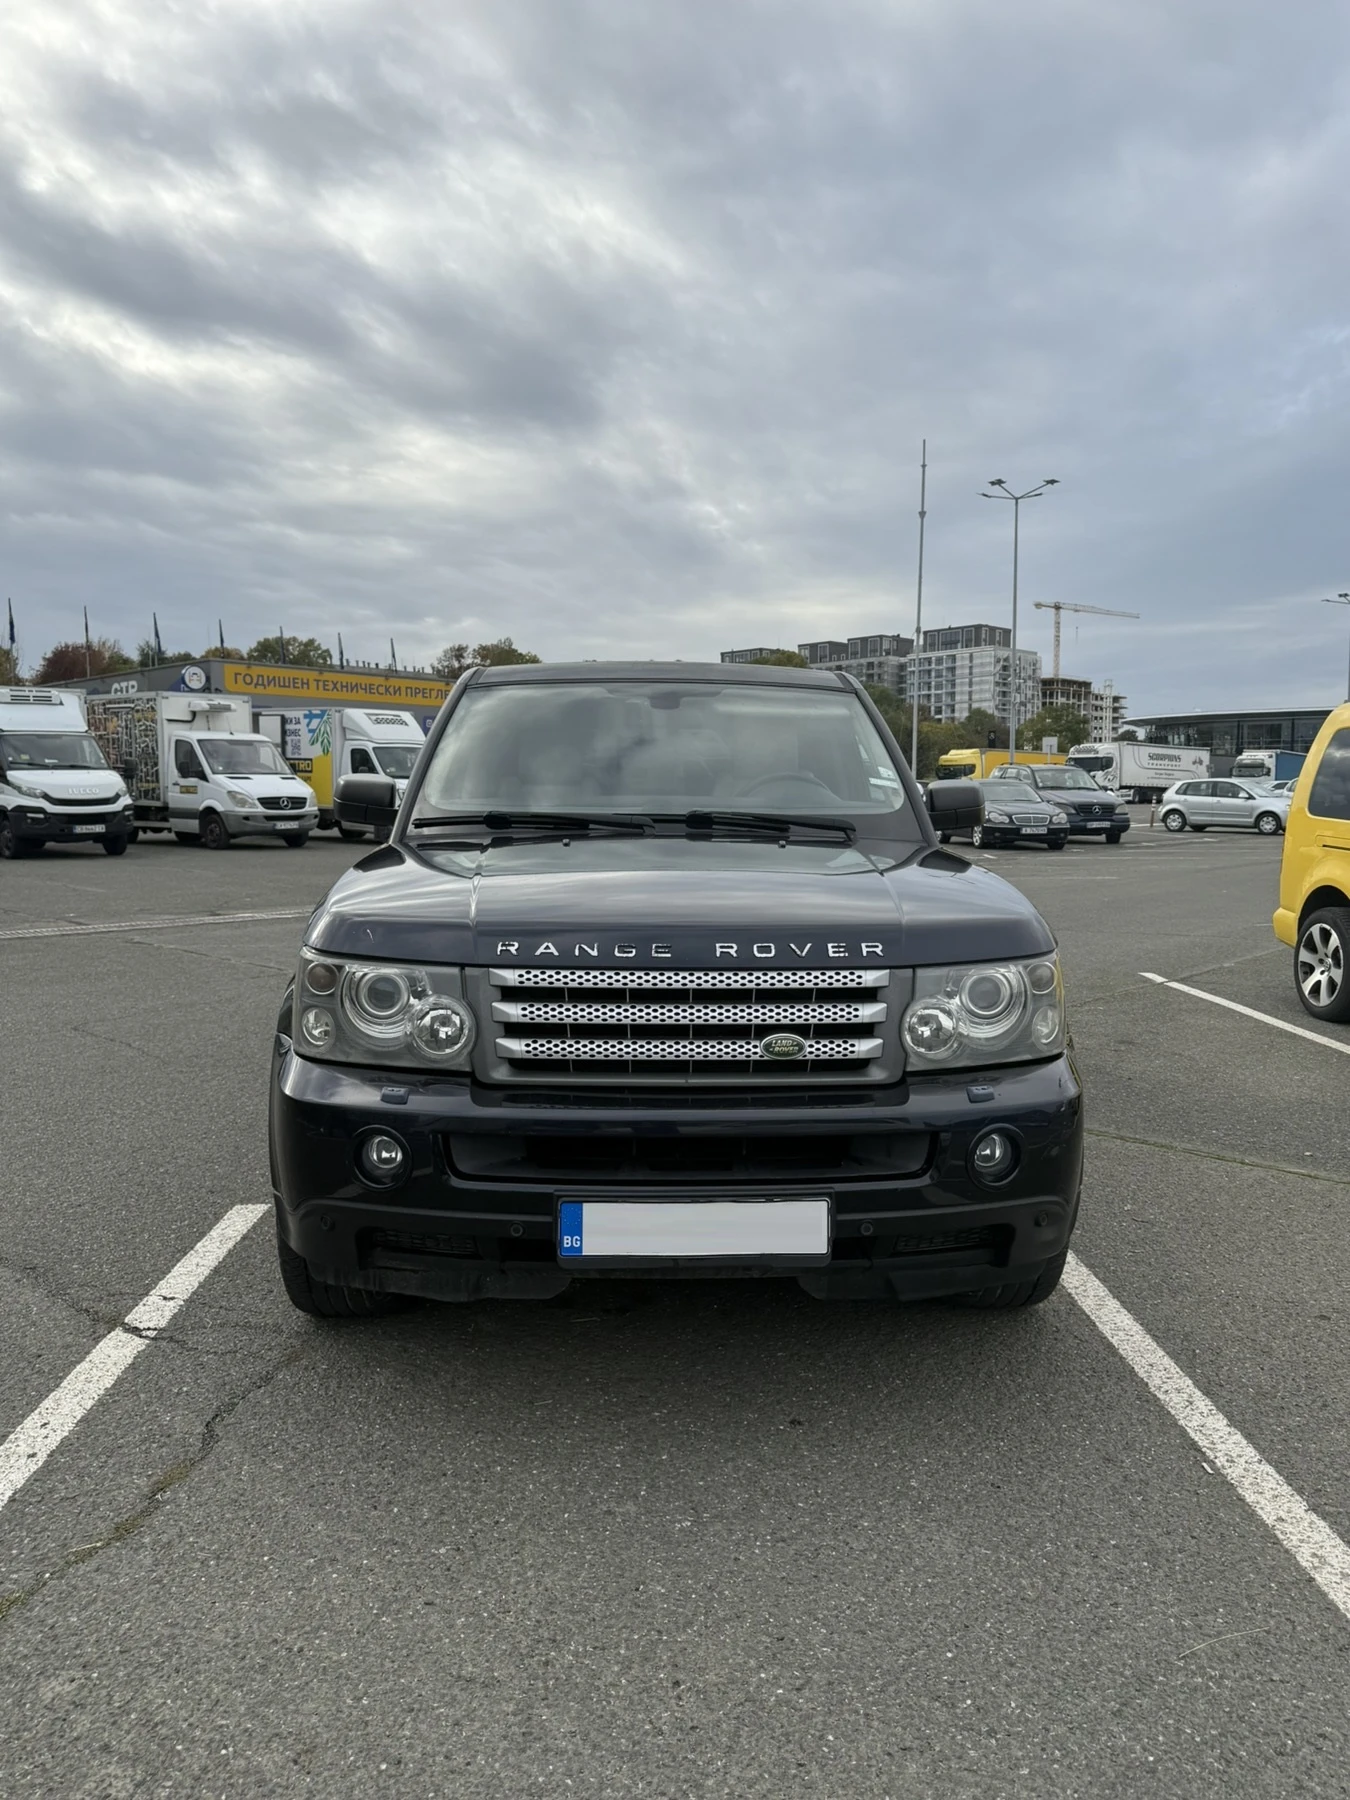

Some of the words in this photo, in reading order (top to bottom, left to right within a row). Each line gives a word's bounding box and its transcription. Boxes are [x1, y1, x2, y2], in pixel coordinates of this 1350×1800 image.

[234, 672, 310, 690] ГОДИШЕН
[314, 679, 401, 697] ТЕХНИЧЕСКИ
[68, 787, 99, 795] IVECO
[496, 942, 672, 957] RANGE
[715, 942, 884, 958] ROVER
[773, 1046, 799, 1054] ROVER
[563, 1235, 581, 1248] BG
